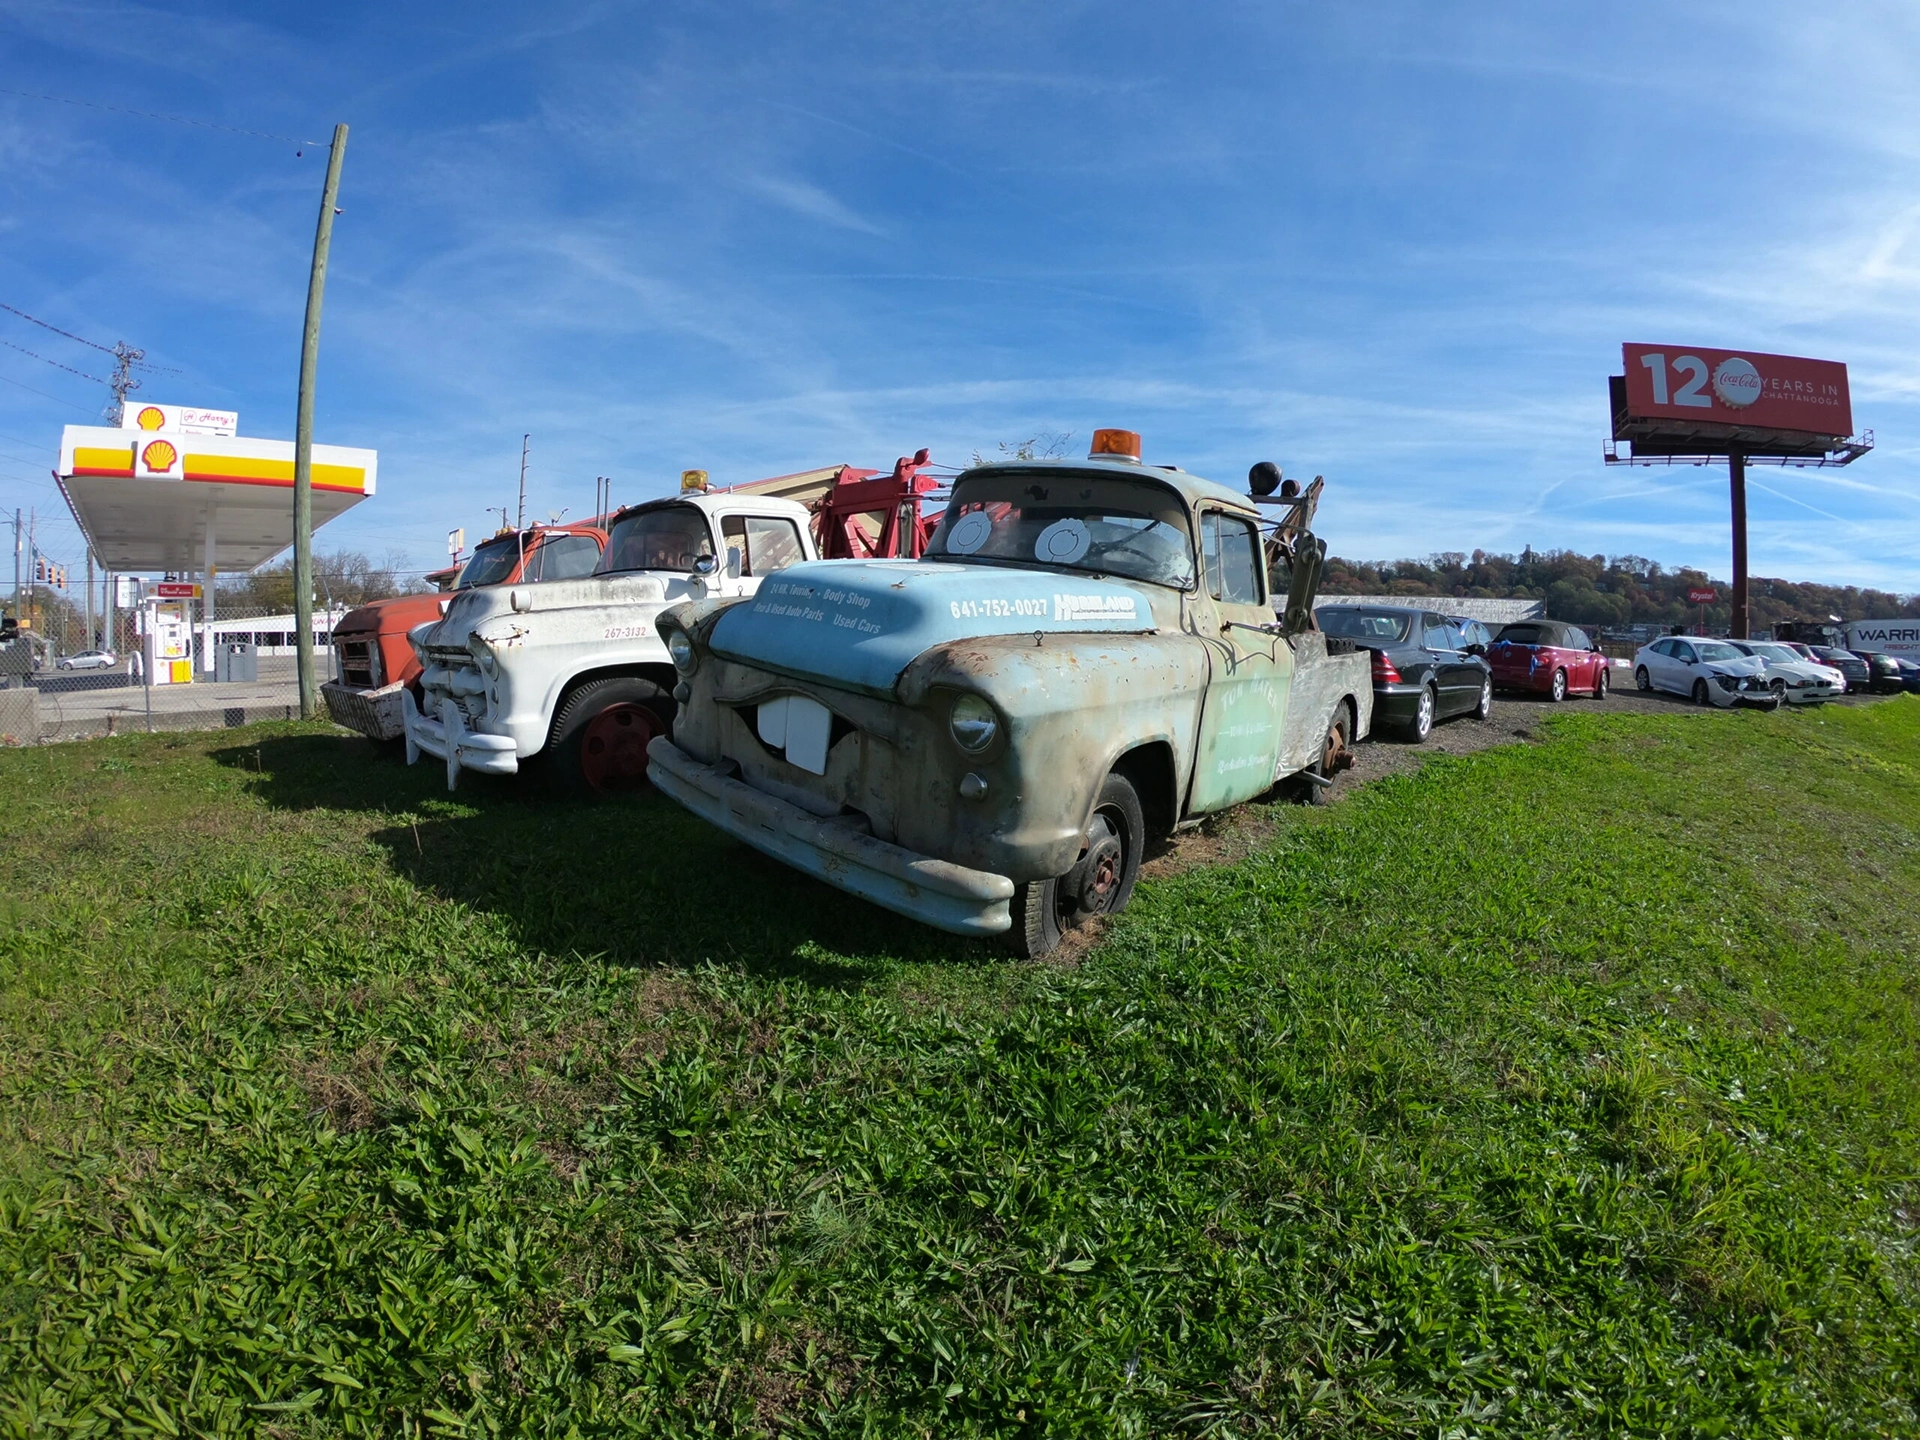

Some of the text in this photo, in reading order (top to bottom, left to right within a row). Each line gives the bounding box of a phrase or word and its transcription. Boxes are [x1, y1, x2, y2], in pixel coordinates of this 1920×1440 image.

[1720, 372, 1760, 388] Coca-Cola
[1760, 377, 1838, 396] YEARS IN
[1762, 391, 1839, 406] CHATTANOOGA
[199, 412, 235, 426] Harry's
[770, 583, 779, 594] 24
[823, 588, 846, 604] Body
[846, 592, 870, 610] Shop
[1690, 592, 1714, 601] Krystal
[770, 603, 788, 615] Used
[785, 605, 802, 617] Auto
[950, 598, 1047, 619] 641-752-0027
[833, 614, 882, 634] Used Cars
[604, 626, 646, 638] 267-3132
